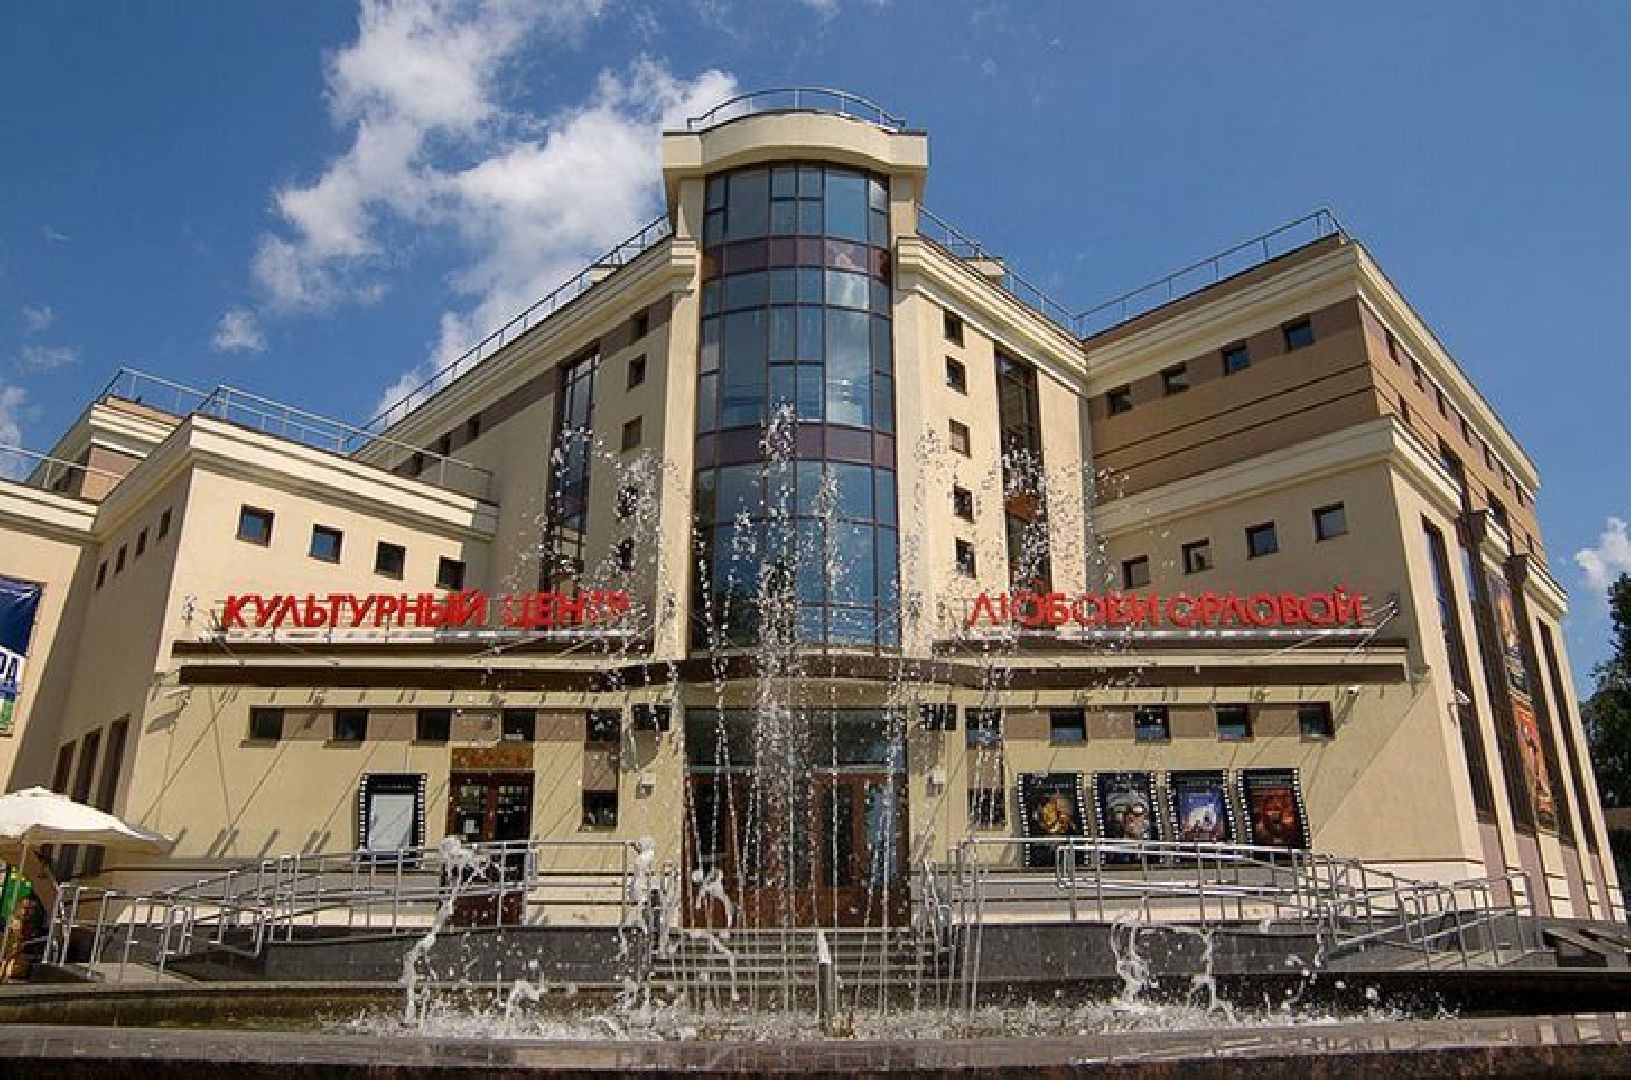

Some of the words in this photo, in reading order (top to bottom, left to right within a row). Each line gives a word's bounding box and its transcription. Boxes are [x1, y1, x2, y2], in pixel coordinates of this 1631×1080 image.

[223, 589, 488, 628] КУЛЬТУРНЫЙ
[968, 592, 1160, 627] ЛЮБОВИ
[1166, 584, 1365, 627] ОРЛОВОЙ
